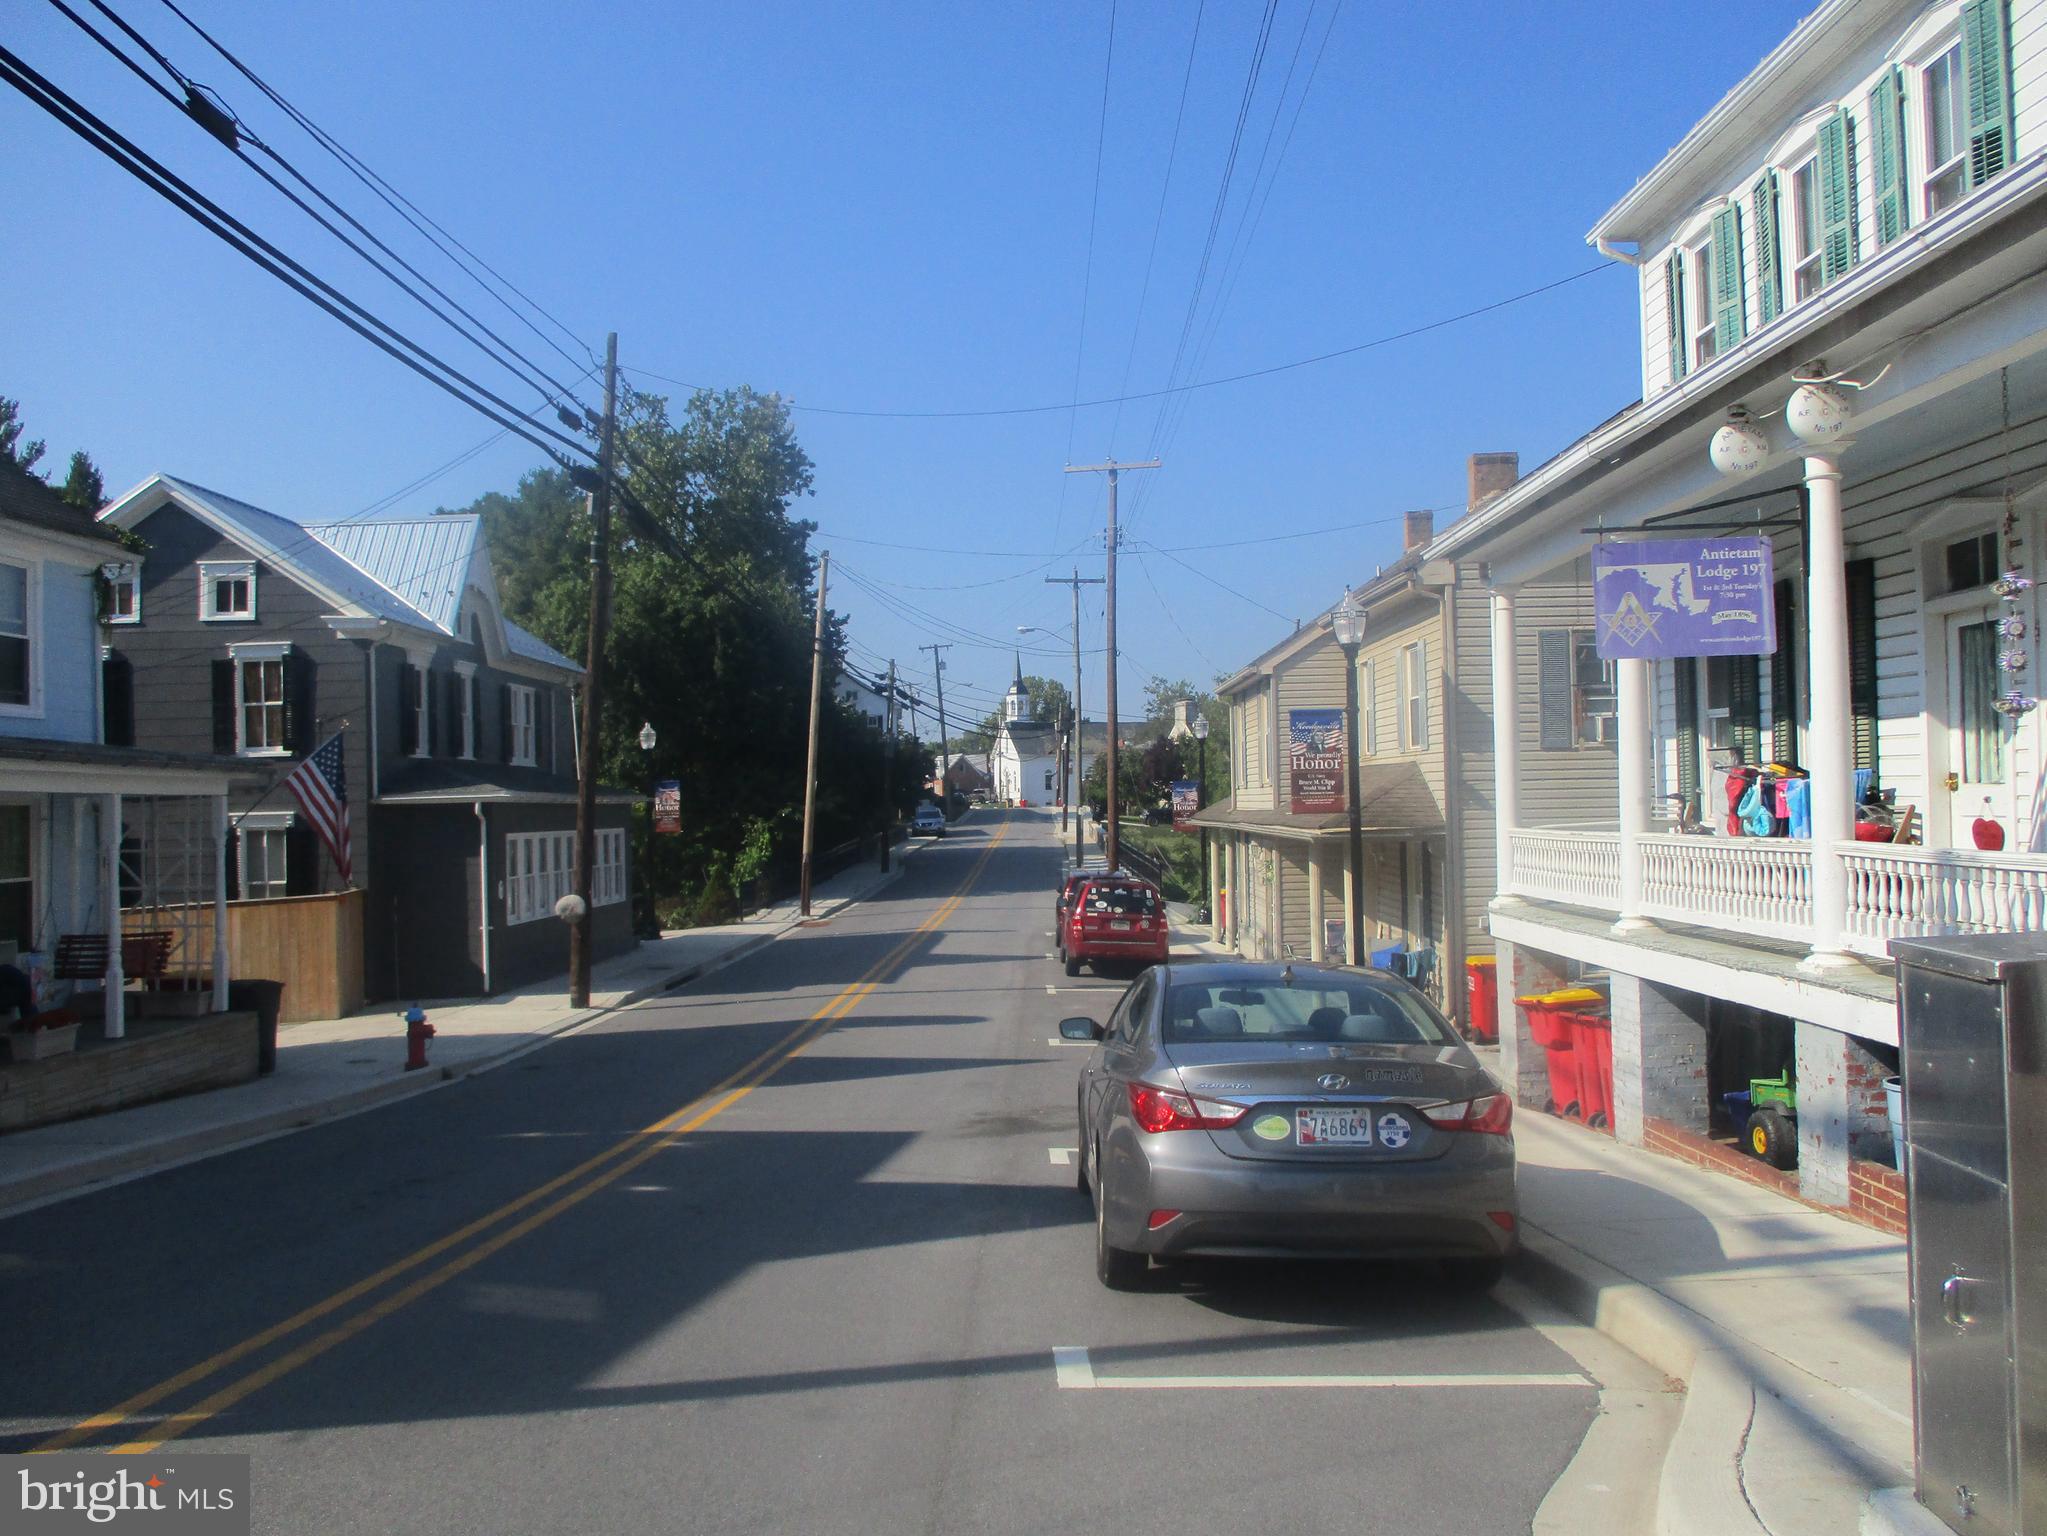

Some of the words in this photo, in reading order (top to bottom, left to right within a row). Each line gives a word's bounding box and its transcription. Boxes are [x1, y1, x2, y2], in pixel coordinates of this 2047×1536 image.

[1700, 548, 1761, 560] Antietam
[1696, 564, 1738, 580] Lodge
[1742, 563, 1767, 576] 197
[1317, 752, 1341, 760] proudly
[1292, 756, 1341, 770] Honor
[655, 804, 680, 812] Honor
[1173, 803, 1198, 811] Honor
